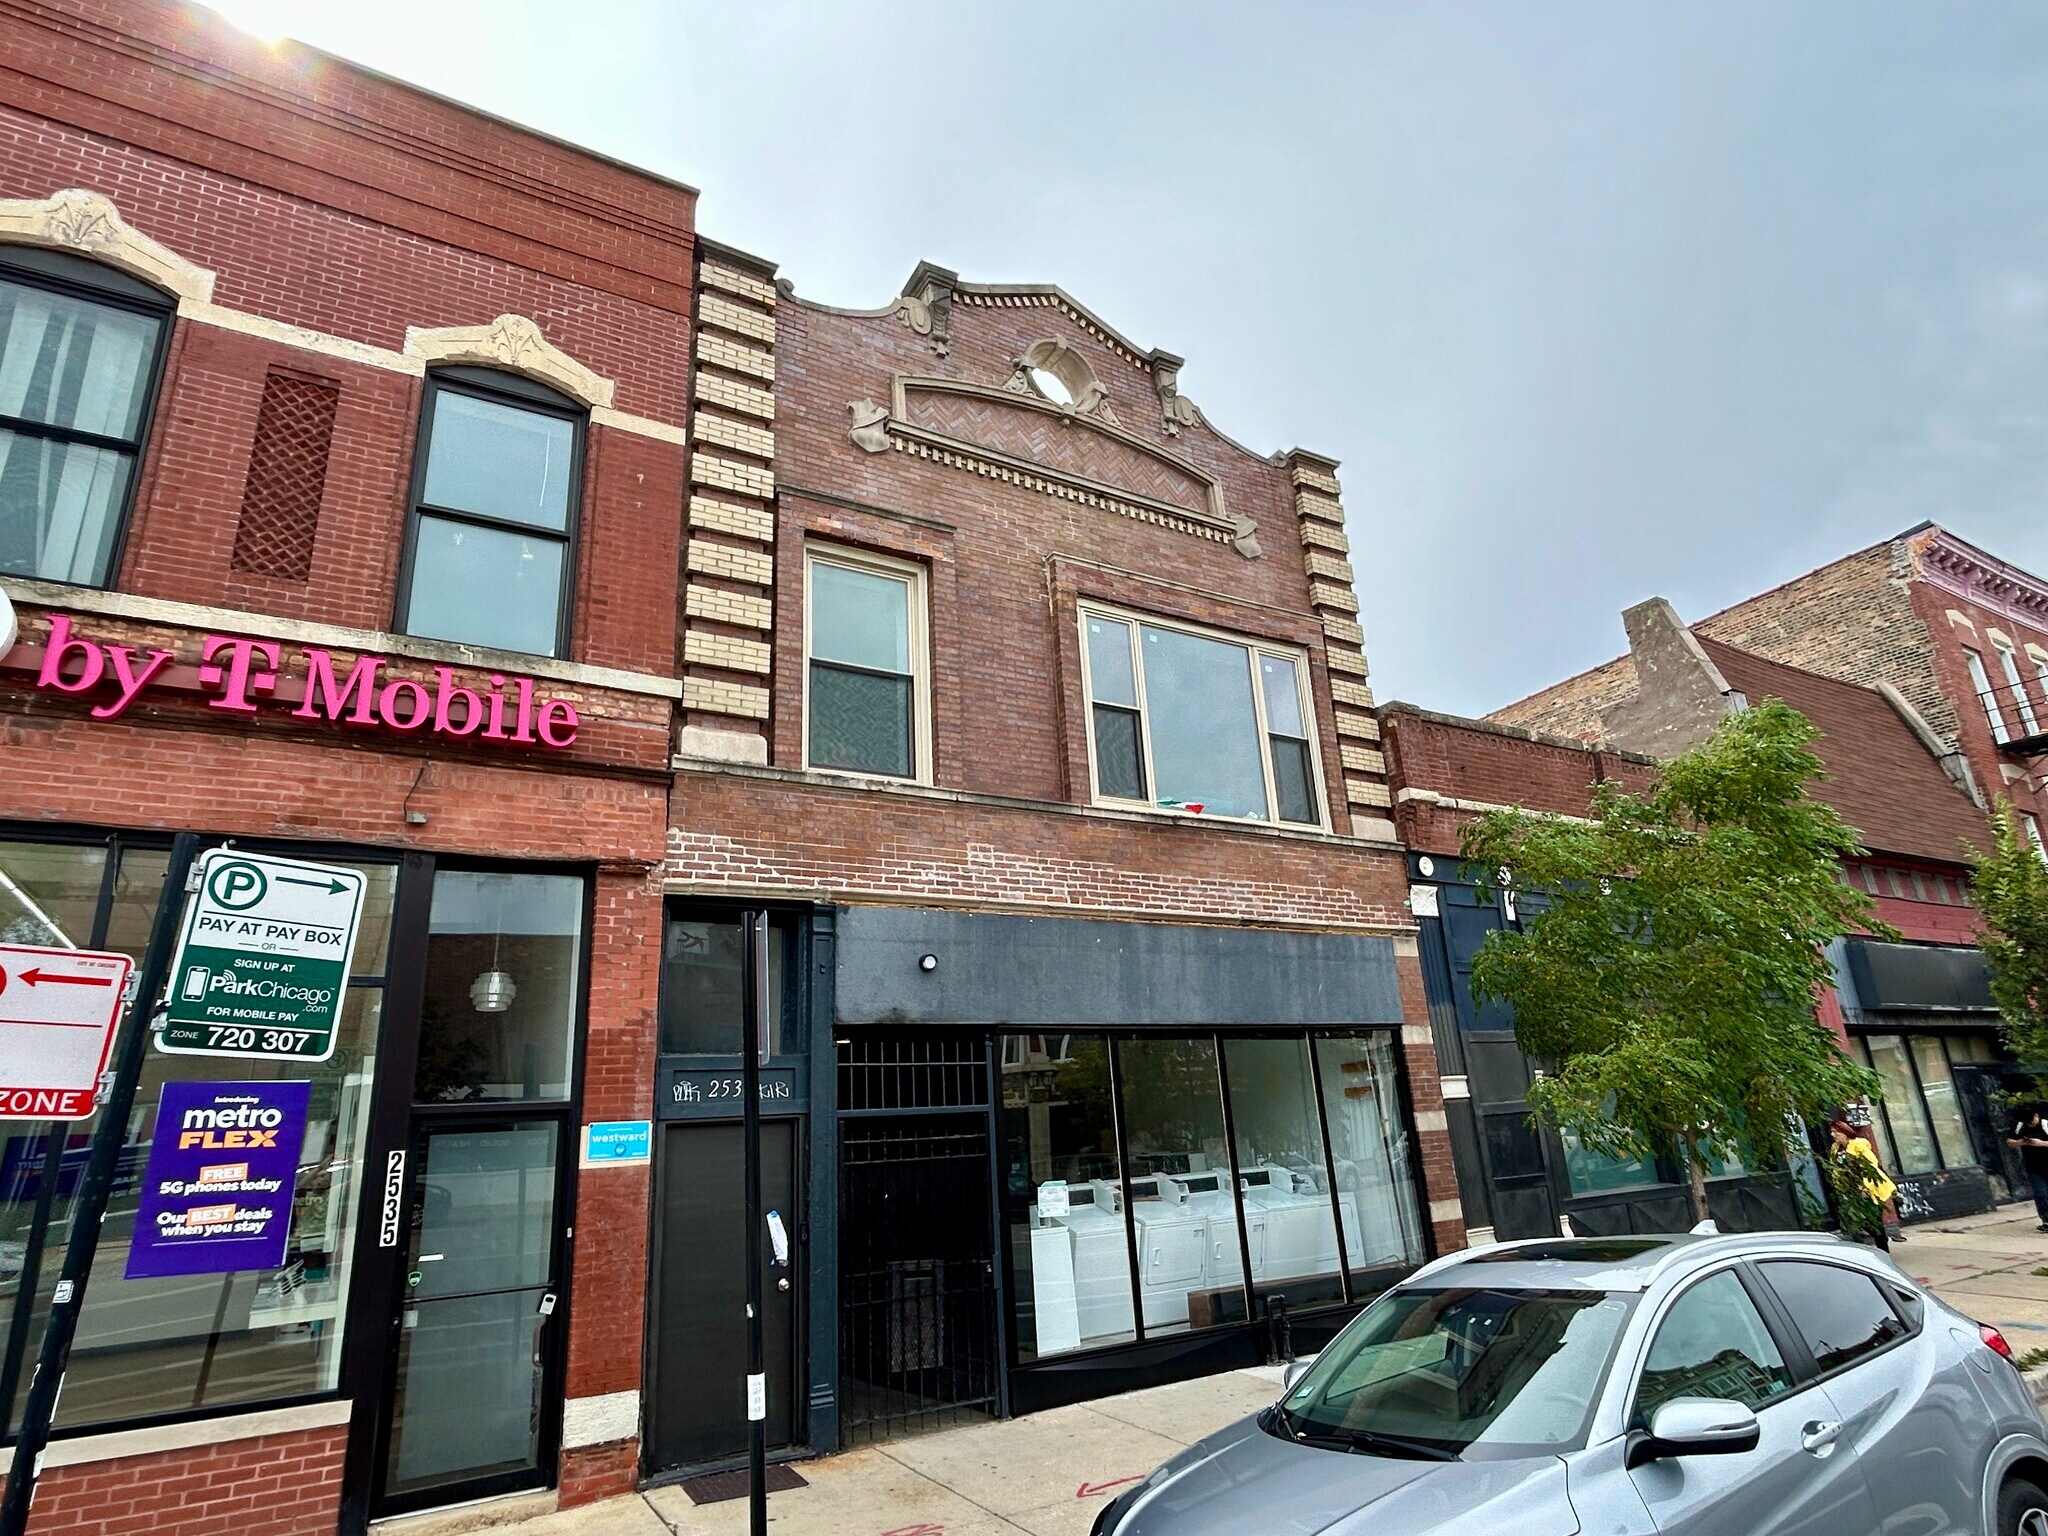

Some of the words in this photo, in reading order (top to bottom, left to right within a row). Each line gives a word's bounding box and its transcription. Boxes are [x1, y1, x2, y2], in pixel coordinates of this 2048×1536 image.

[37, 613, 173, 721] by
[292, 648, 579, 749] Mobile
[223, 870, 255, 900] P
[199, 917, 236, 932] PAY
[237, 922, 262, 936] AT
[265, 925, 301, 941] PAY
[304, 930, 343, 946] BOX
[261, 942, 277, 951] OR
[233, 958, 262, 970] SIGN
[263, 961, 279, 972] UP
[280, 963, 296, 973] AT
[209, 976, 332, 1005] ParkChicago
[206, 1006, 231, 1018] FOR
[232, 1009, 276, 1021] MOBILE
[278, 1011, 300, 1022] PAY
[302, 1004, 328, 1014] .com
[170, 1029, 200, 1040] ZONE
[206, 1026, 256, 1050] 720
[261, 1030, 310, 1053] 307
[708, 1080, 743, 1098] 253
[0, 1090, 82, 1113] ZONE
[182, 1104, 283, 1130] metro
[178, 1129, 279, 1150] FLEX
[592, 1130, 647, 1143] westward
[202, 1166, 245, 1182] FREE
[159, 1180, 184, 1195] 5G
[184, 1180, 239, 1197] phones
[240, 1178, 282, 1194] today
[382, 1152, 402, 1245] 2535
[156, 1211, 189, 1225] Our
[190, 1207, 233, 1223] BEST
[233, 1207, 273, 1221] deals
[161, 1223, 203, 1237] when
[203, 1223, 233, 1237] you
[234, 1221, 266, 1234] stay
